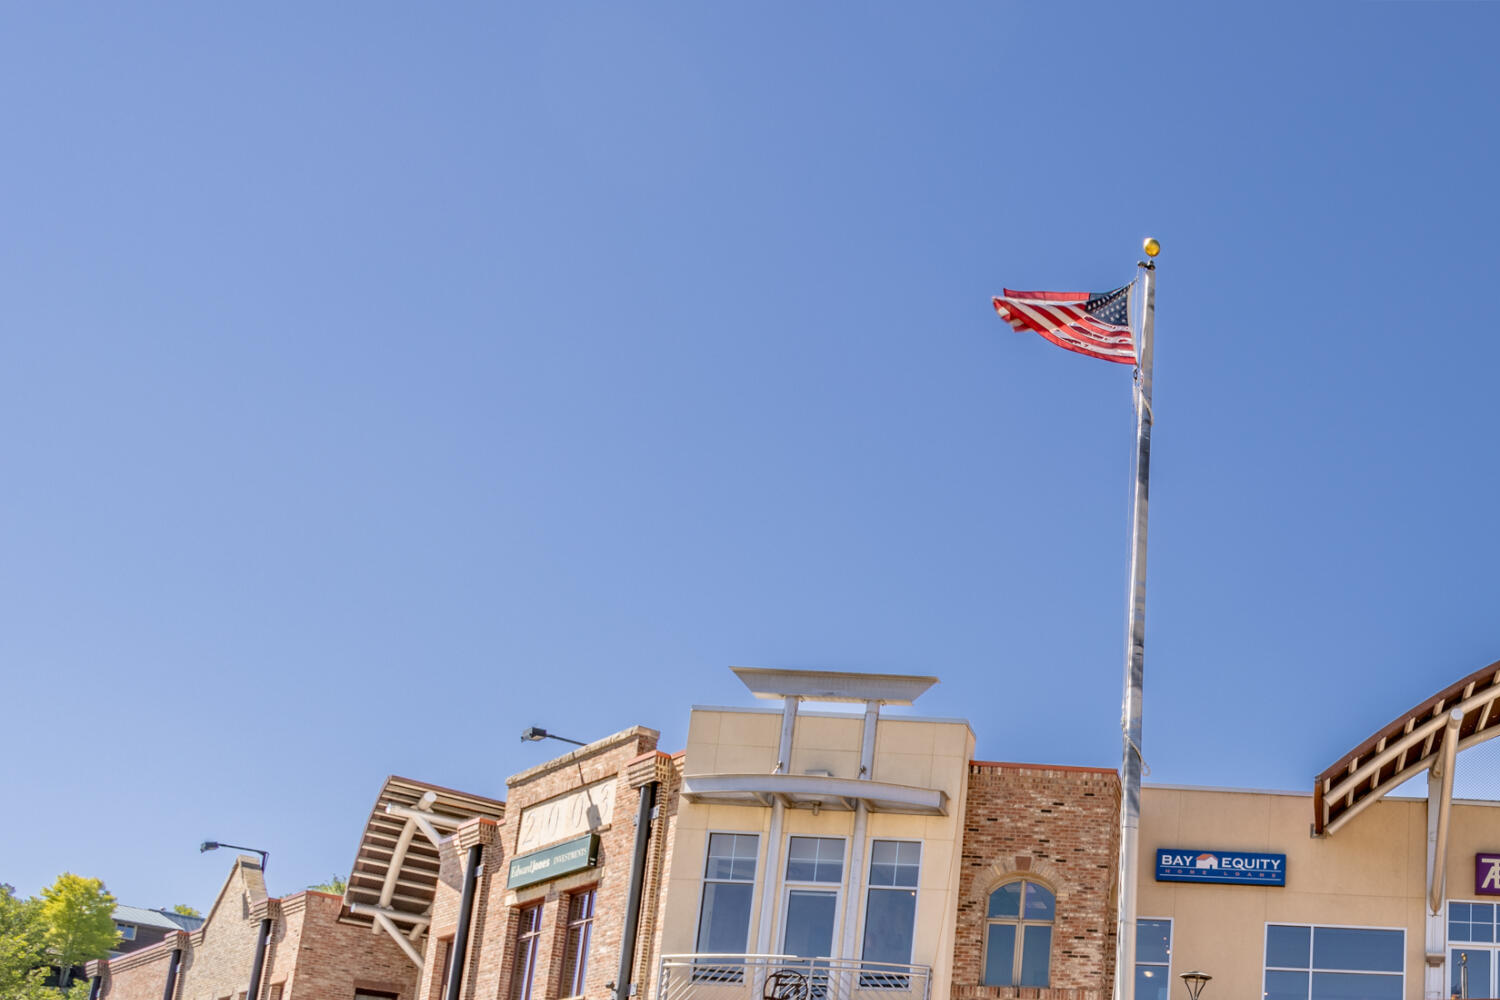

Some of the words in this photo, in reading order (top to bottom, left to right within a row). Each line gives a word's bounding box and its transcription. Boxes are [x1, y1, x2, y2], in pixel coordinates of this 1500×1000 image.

[522, 783, 610, 847] 2003
[1161, 854, 1194, 866] BAY
[1221, 857, 1281, 871] EQUITY
